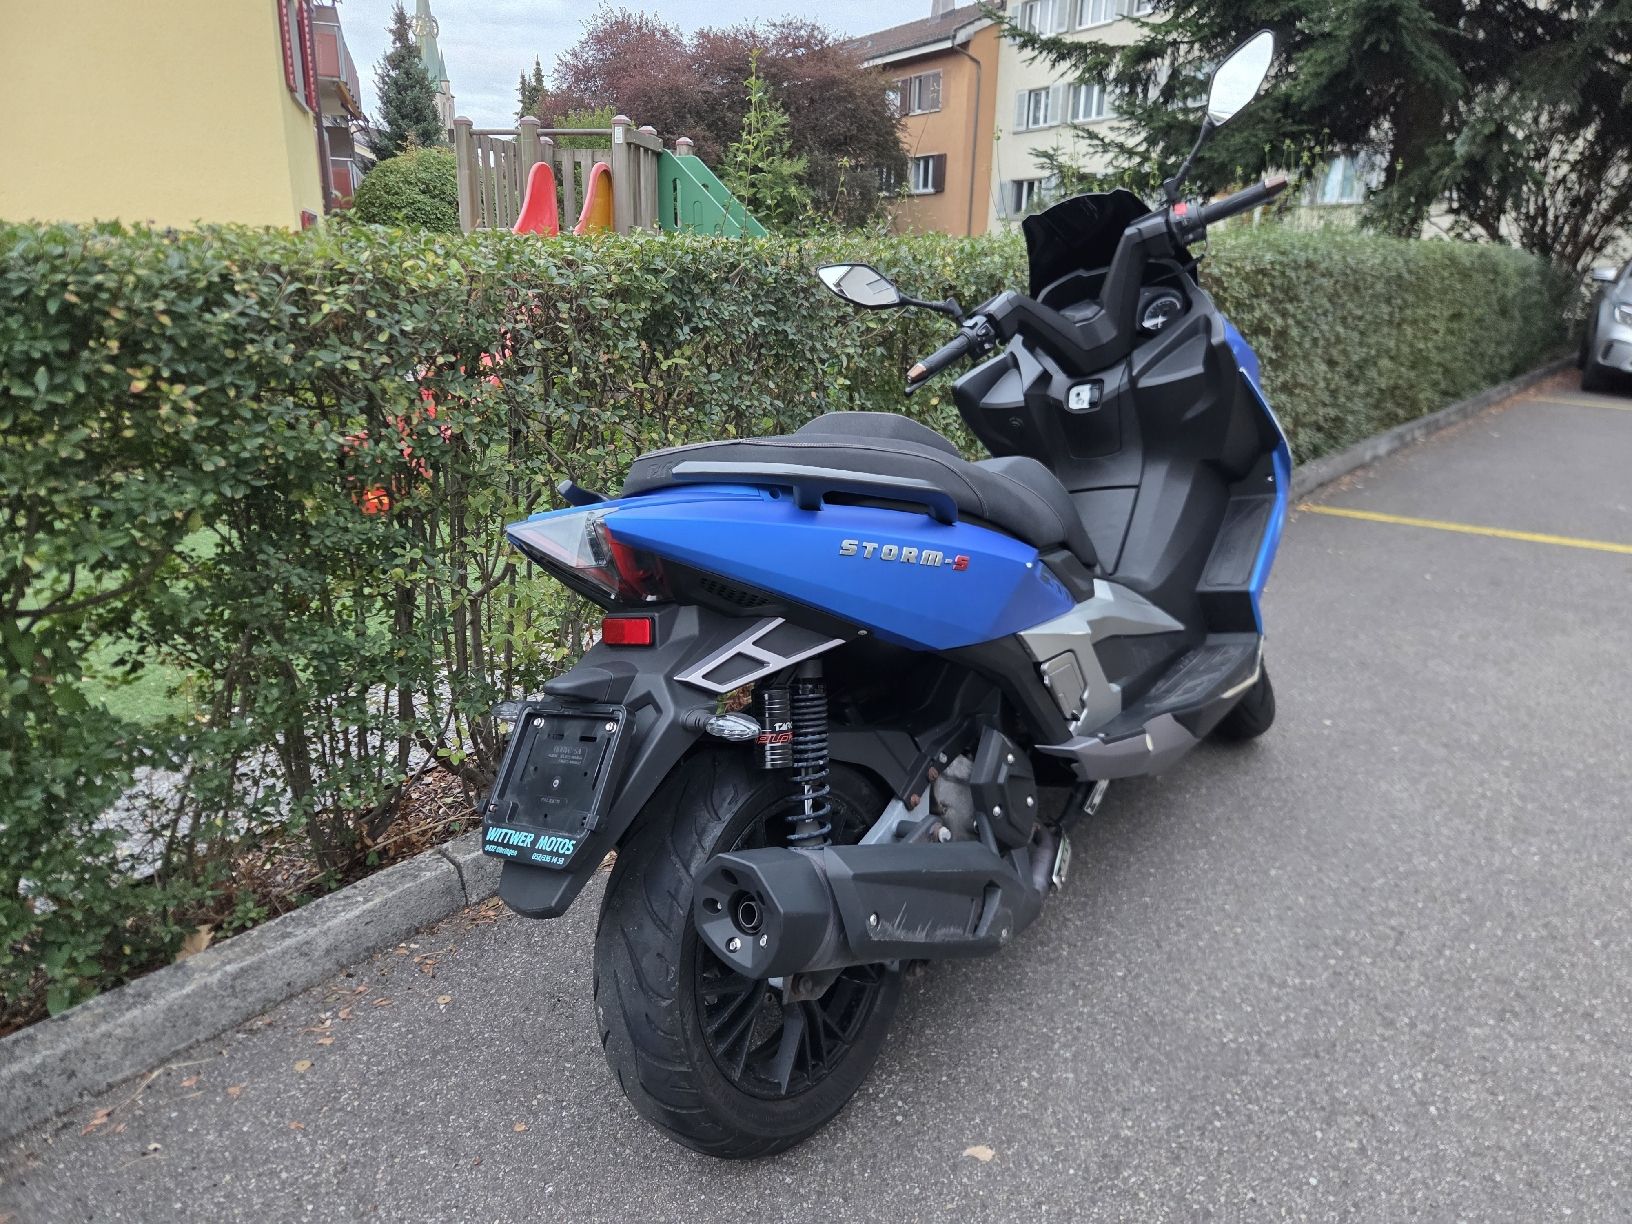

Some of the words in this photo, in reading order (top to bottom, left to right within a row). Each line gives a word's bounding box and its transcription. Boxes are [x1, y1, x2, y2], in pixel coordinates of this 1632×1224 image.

[839, 539, 970, 571] STORM-S
[485, 826, 535, 848] WITTWER
[535, 835, 577, 855] MOTOS
